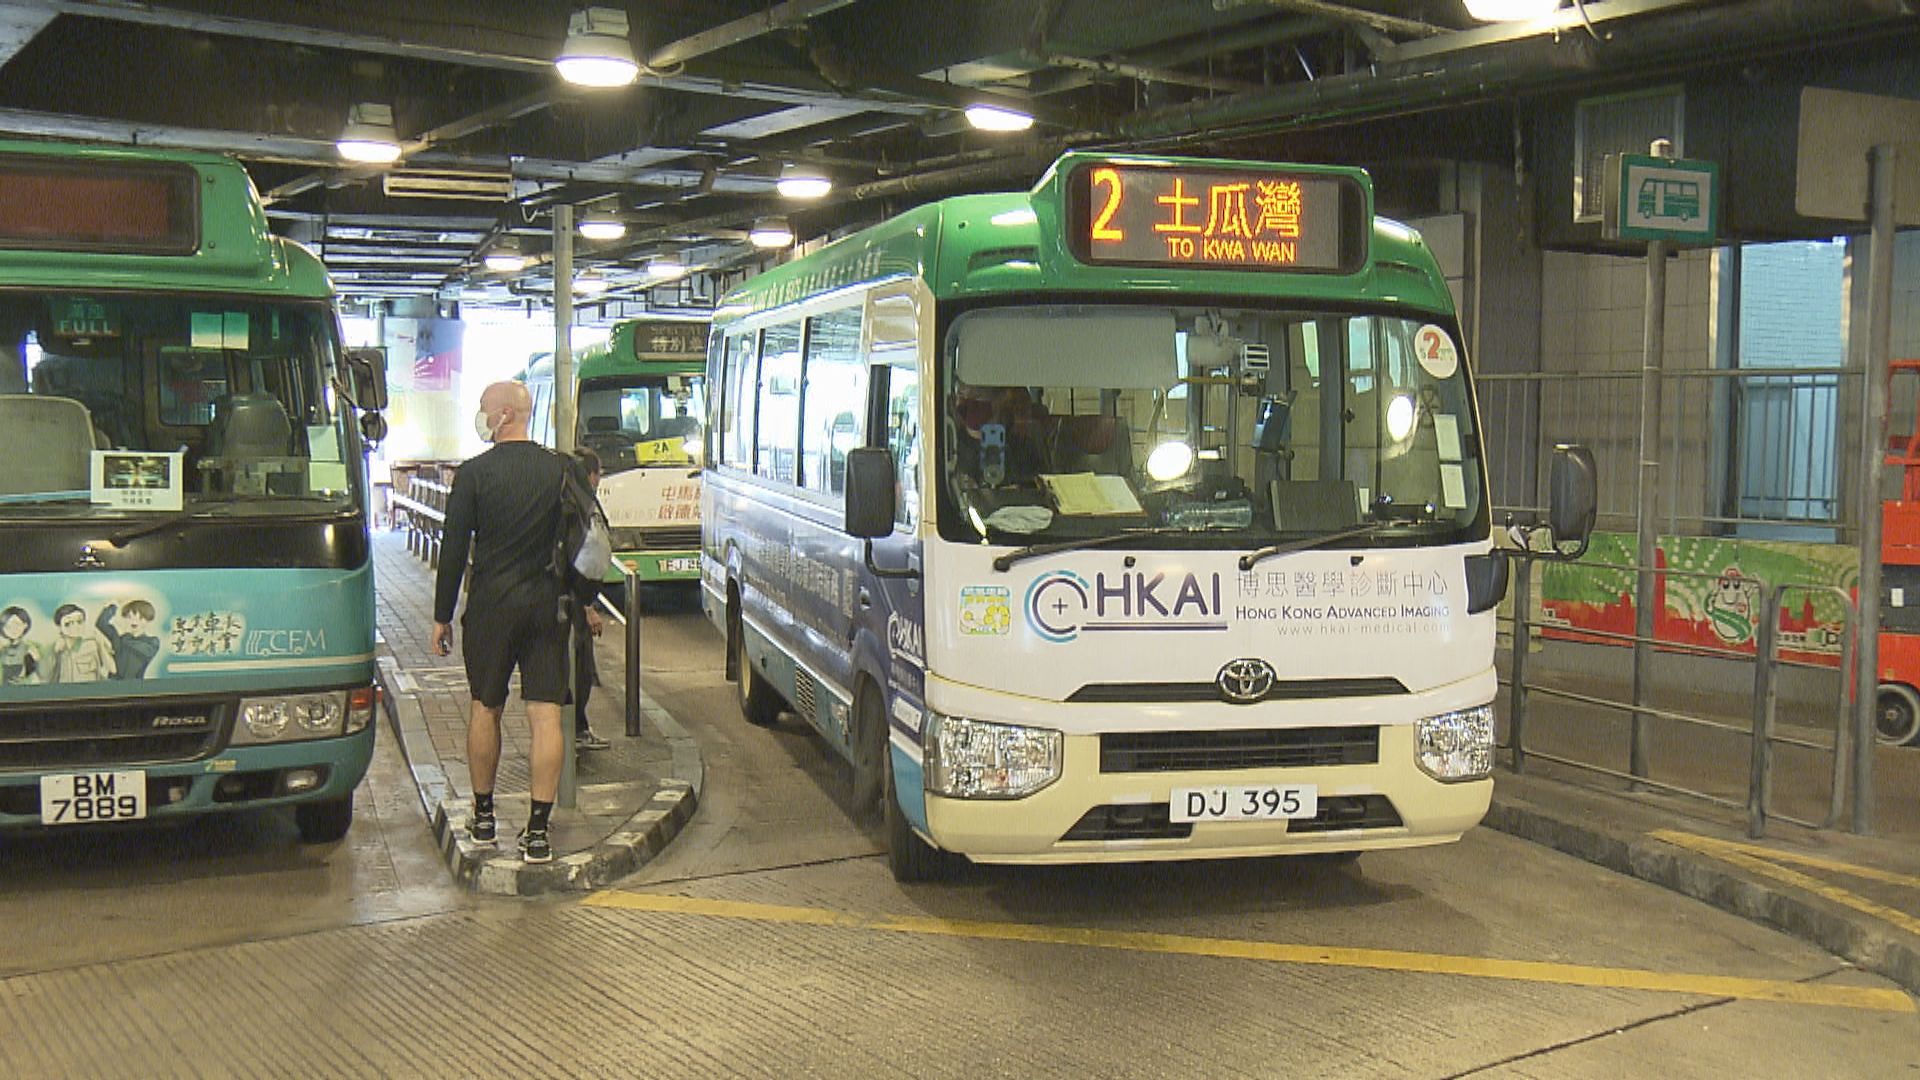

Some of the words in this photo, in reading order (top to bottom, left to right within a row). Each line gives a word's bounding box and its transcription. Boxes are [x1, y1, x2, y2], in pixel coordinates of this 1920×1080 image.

[1091, 167, 1124, 242] 2
[1153, 176, 1301, 240] 土瓜灣
[1167, 236, 1195, 259] TO
[1203, 237, 1247, 262] KWA
[1250, 240, 1297, 264] WAN
[59, 319, 113, 335] FULL
[1423, 332, 1441, 360] 2
[653, 442, 669, 455] 2A
[1096, 572, 1222, 617] HKAI
[1236, 570, 1449, 598] 博思醫學診斷中心
[73, 773, 115, 797] BM
[52, 795, 137, 822] 7889
[1187, 790, 1228, 817] DJ
[1241, 788, 1301, 816] 395
